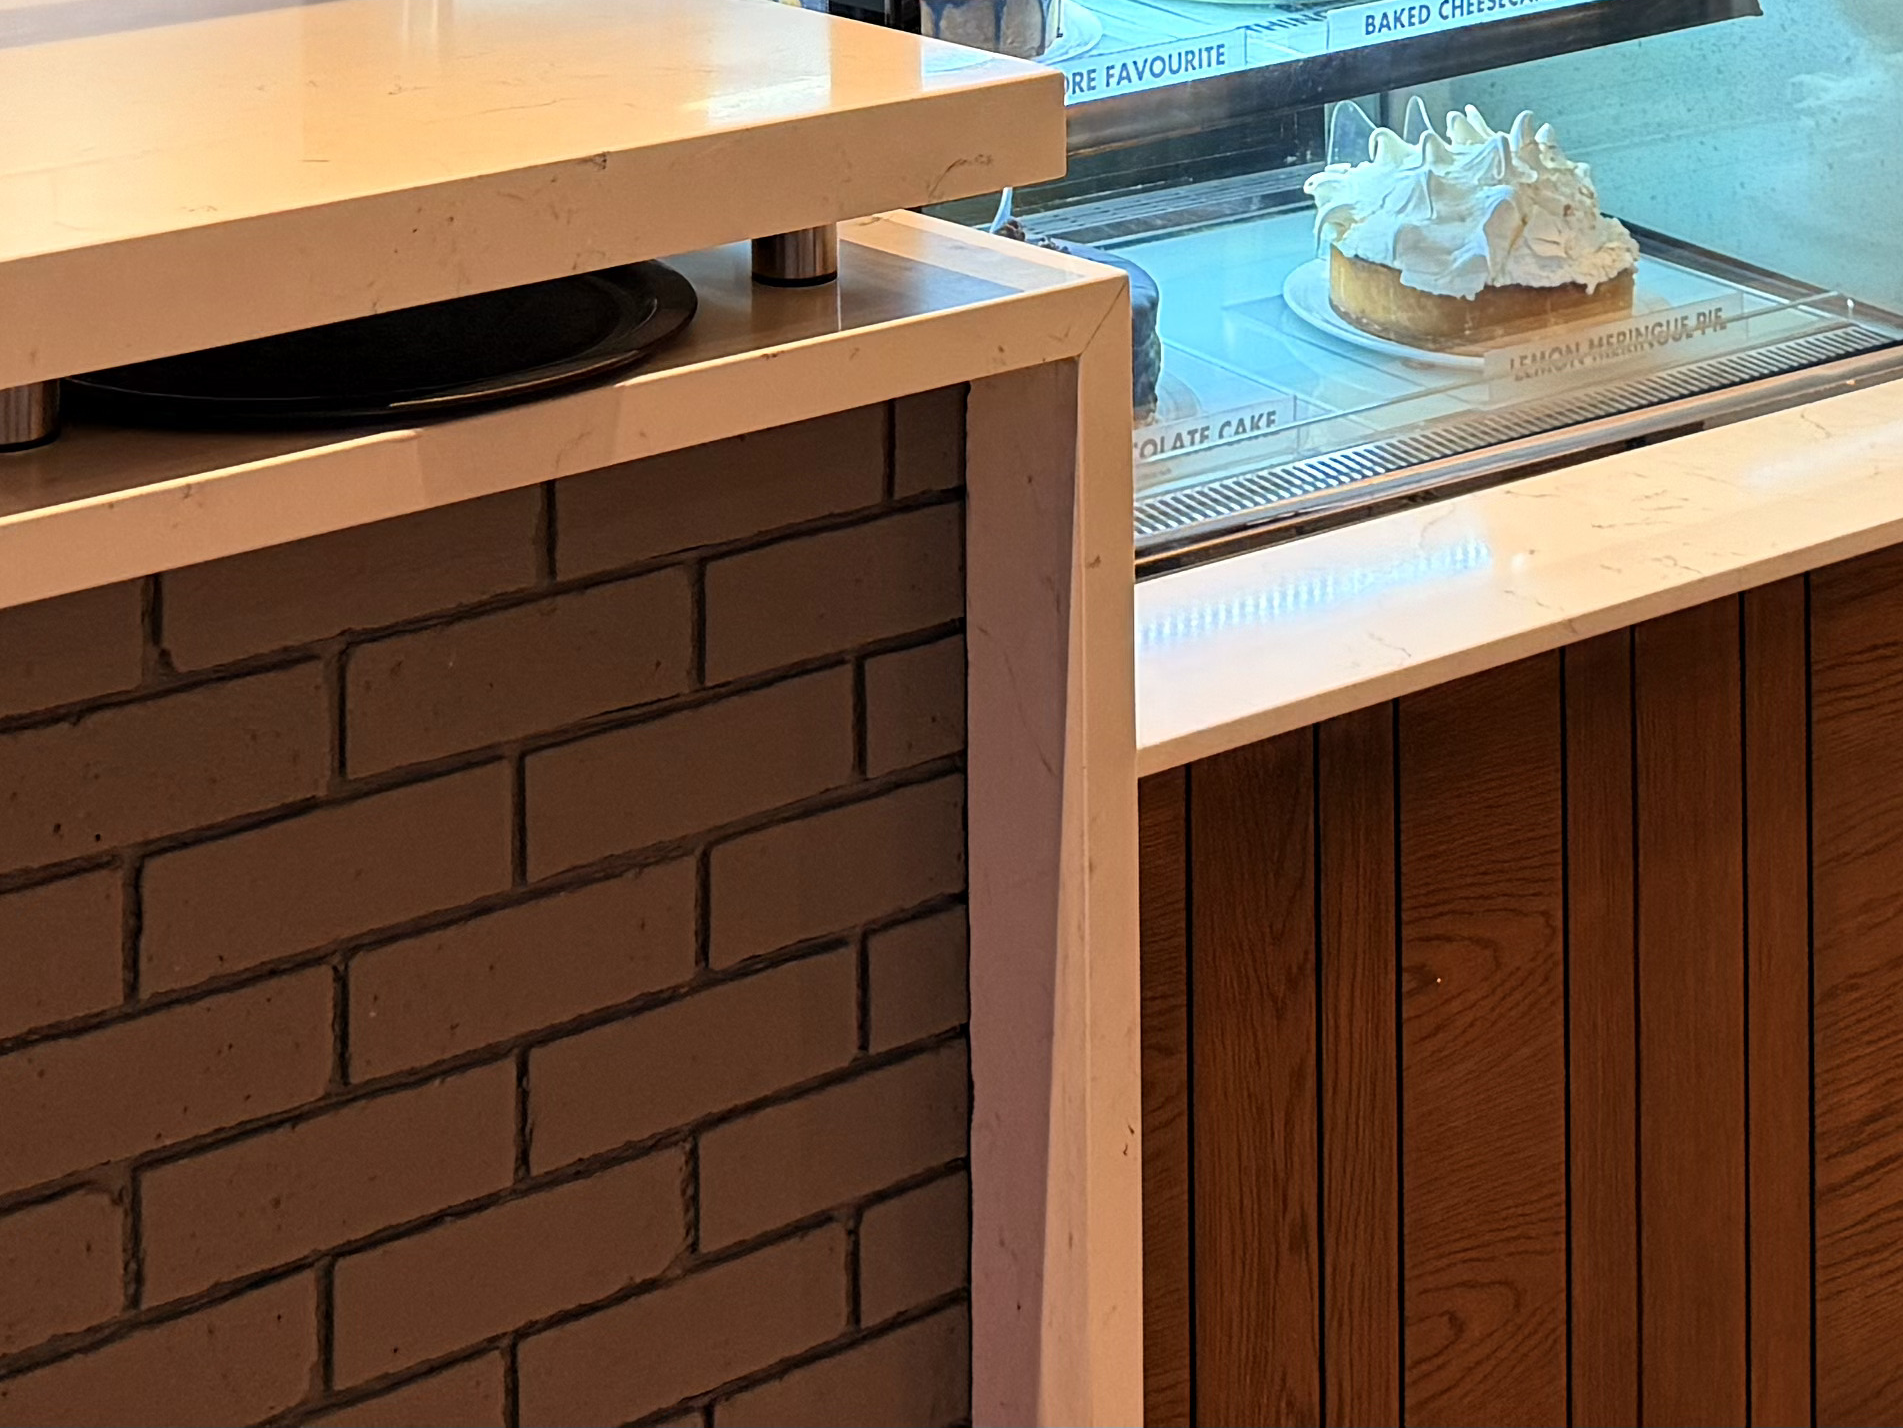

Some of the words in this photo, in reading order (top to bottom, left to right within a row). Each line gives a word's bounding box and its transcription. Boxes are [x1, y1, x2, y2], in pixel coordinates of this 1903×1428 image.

[1364, 4, 1431, 36] BAKED
[1065, 68, 1096, 95] RE
[1104, 43, 1226, 88] FAVOURITE
[1509, 342, 1586, 381] LEMON
[1134, 425, 1210, 459] OLATE
[1218, 410, 1277, 439] CAKE
